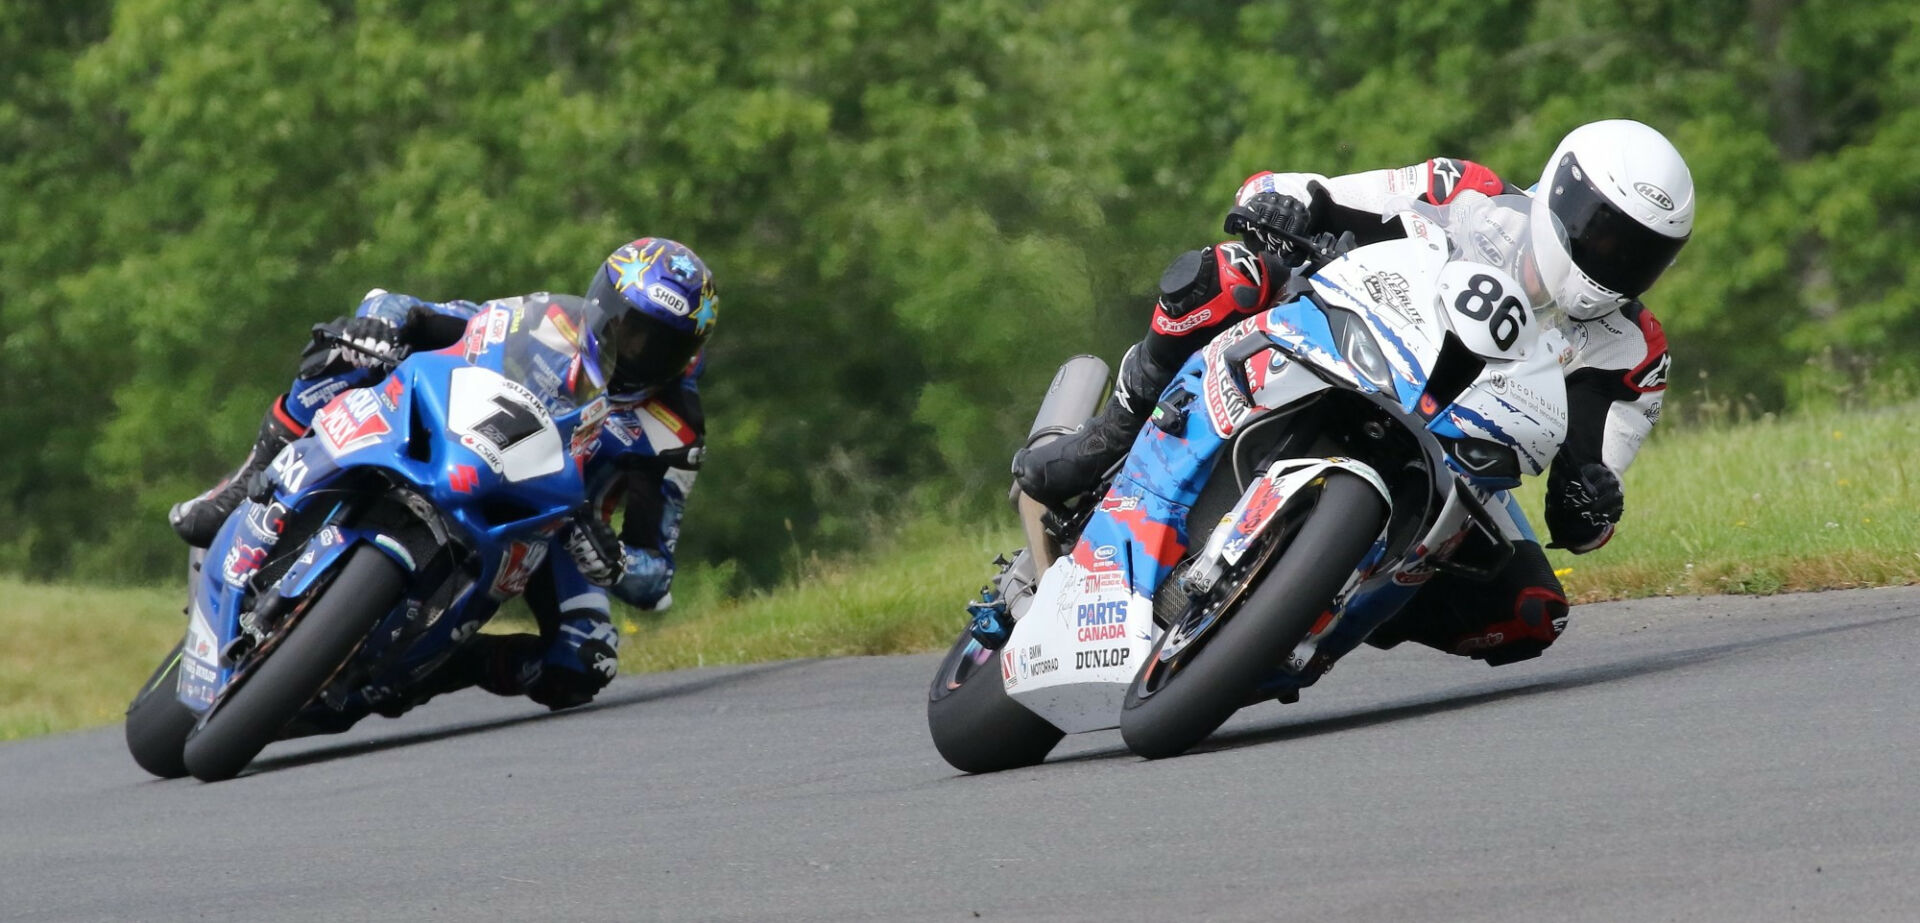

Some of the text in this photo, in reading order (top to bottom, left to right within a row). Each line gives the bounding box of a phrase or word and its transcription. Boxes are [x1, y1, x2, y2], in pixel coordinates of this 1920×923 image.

[1638, 184, 1671, 208] HJC
[653, 287, 685, 312] SHOEI
[1378, 271, 1425, 324] CLEARLITE
[1156, 307, 1212, 333] alpinestars
[1454, 273, 1527, 351] 86
[1598, 319, 1623, 335] NLOP
[505, 380, 548, 419] SUZUKI
[1509, 379, 1566, 420] scot-build
[321, 404, 358, 444] MOLY
[470, 395, 545, 452] 1
[475, 442, 501, 468] CSBK
[1076, 600, 1128, 627] PARTS
[1077, 624, 1126, 642] CANADA
[1029, 644, 1042, 660] BMW
[1075, 647, 1130, 670] DUNLOP
[1030, 657, 1059, 677] MOTORRAD
